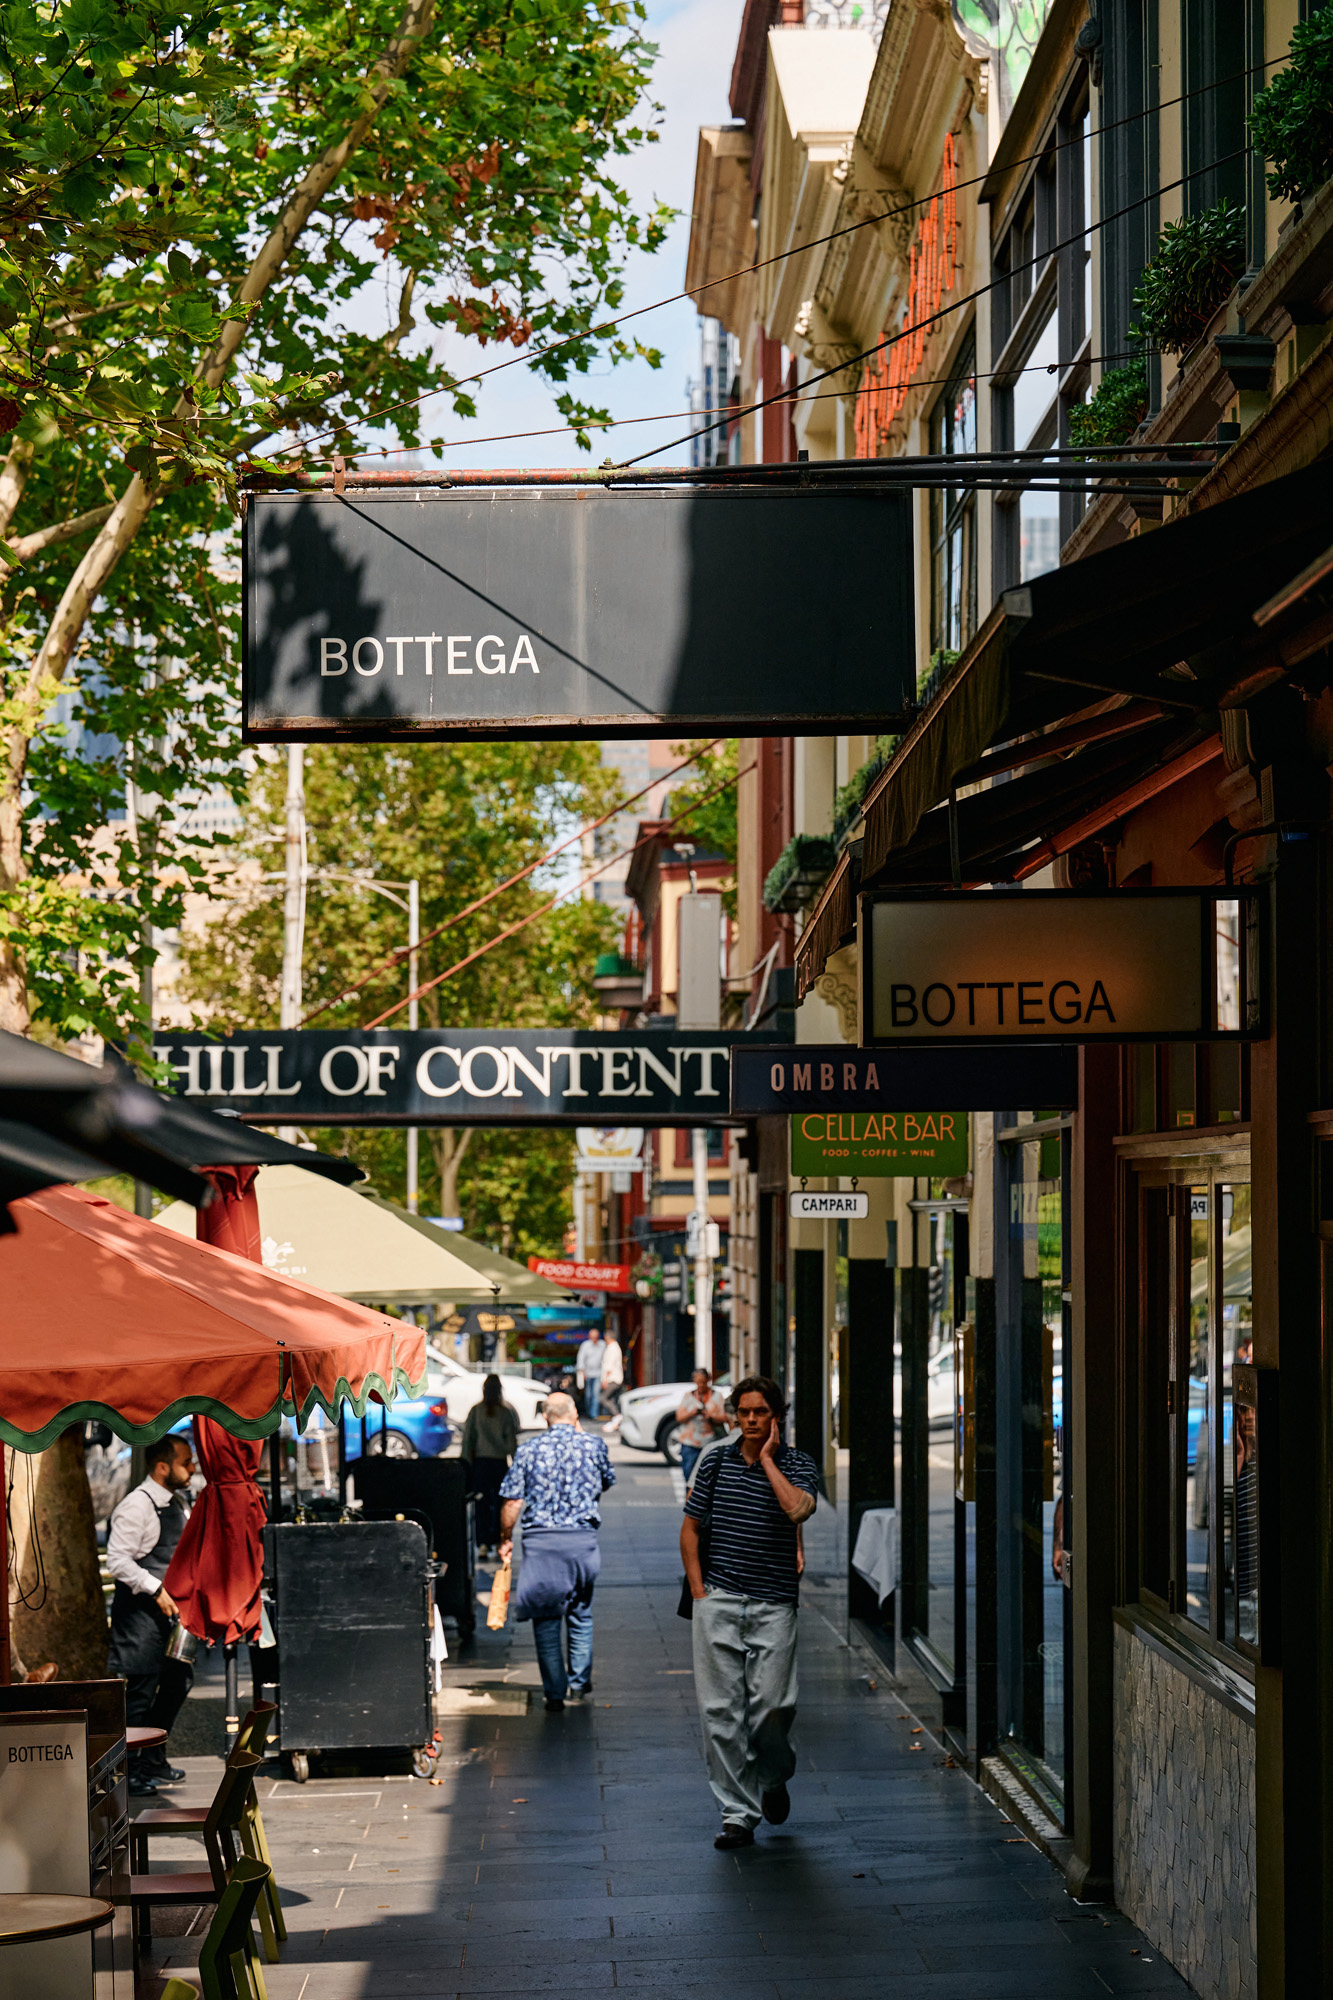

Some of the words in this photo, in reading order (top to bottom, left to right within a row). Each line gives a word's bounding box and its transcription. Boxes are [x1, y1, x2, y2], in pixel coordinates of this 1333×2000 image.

[320, 634, 541, 677] BOTTEGA
[890, 980, 1117, 1028] BOTTEGA
[151, 1045, 302, 1097] HILL
[319, 1045, 400, 1097] OF
[416, 1045, 730, 1098] CONTENT
[770, 1063, 880, 1091] OMBRA
[801, 1113, 898, 1142] CELLAR
[904, 1114, 956, 1142] BAR
[822, 1149, 850, 1157] FOOD
[861, 1149, 898, 1157] COFFEE
[910, 1149, 936, 1157] WINE
[801, 1198, 857, 1211] CAMPARI
[536, 1262, 575, 1278] FOOD
[575, 1265, 622, 1280] COURT
[8, 1744, 74, 1763] BOTTEGA
